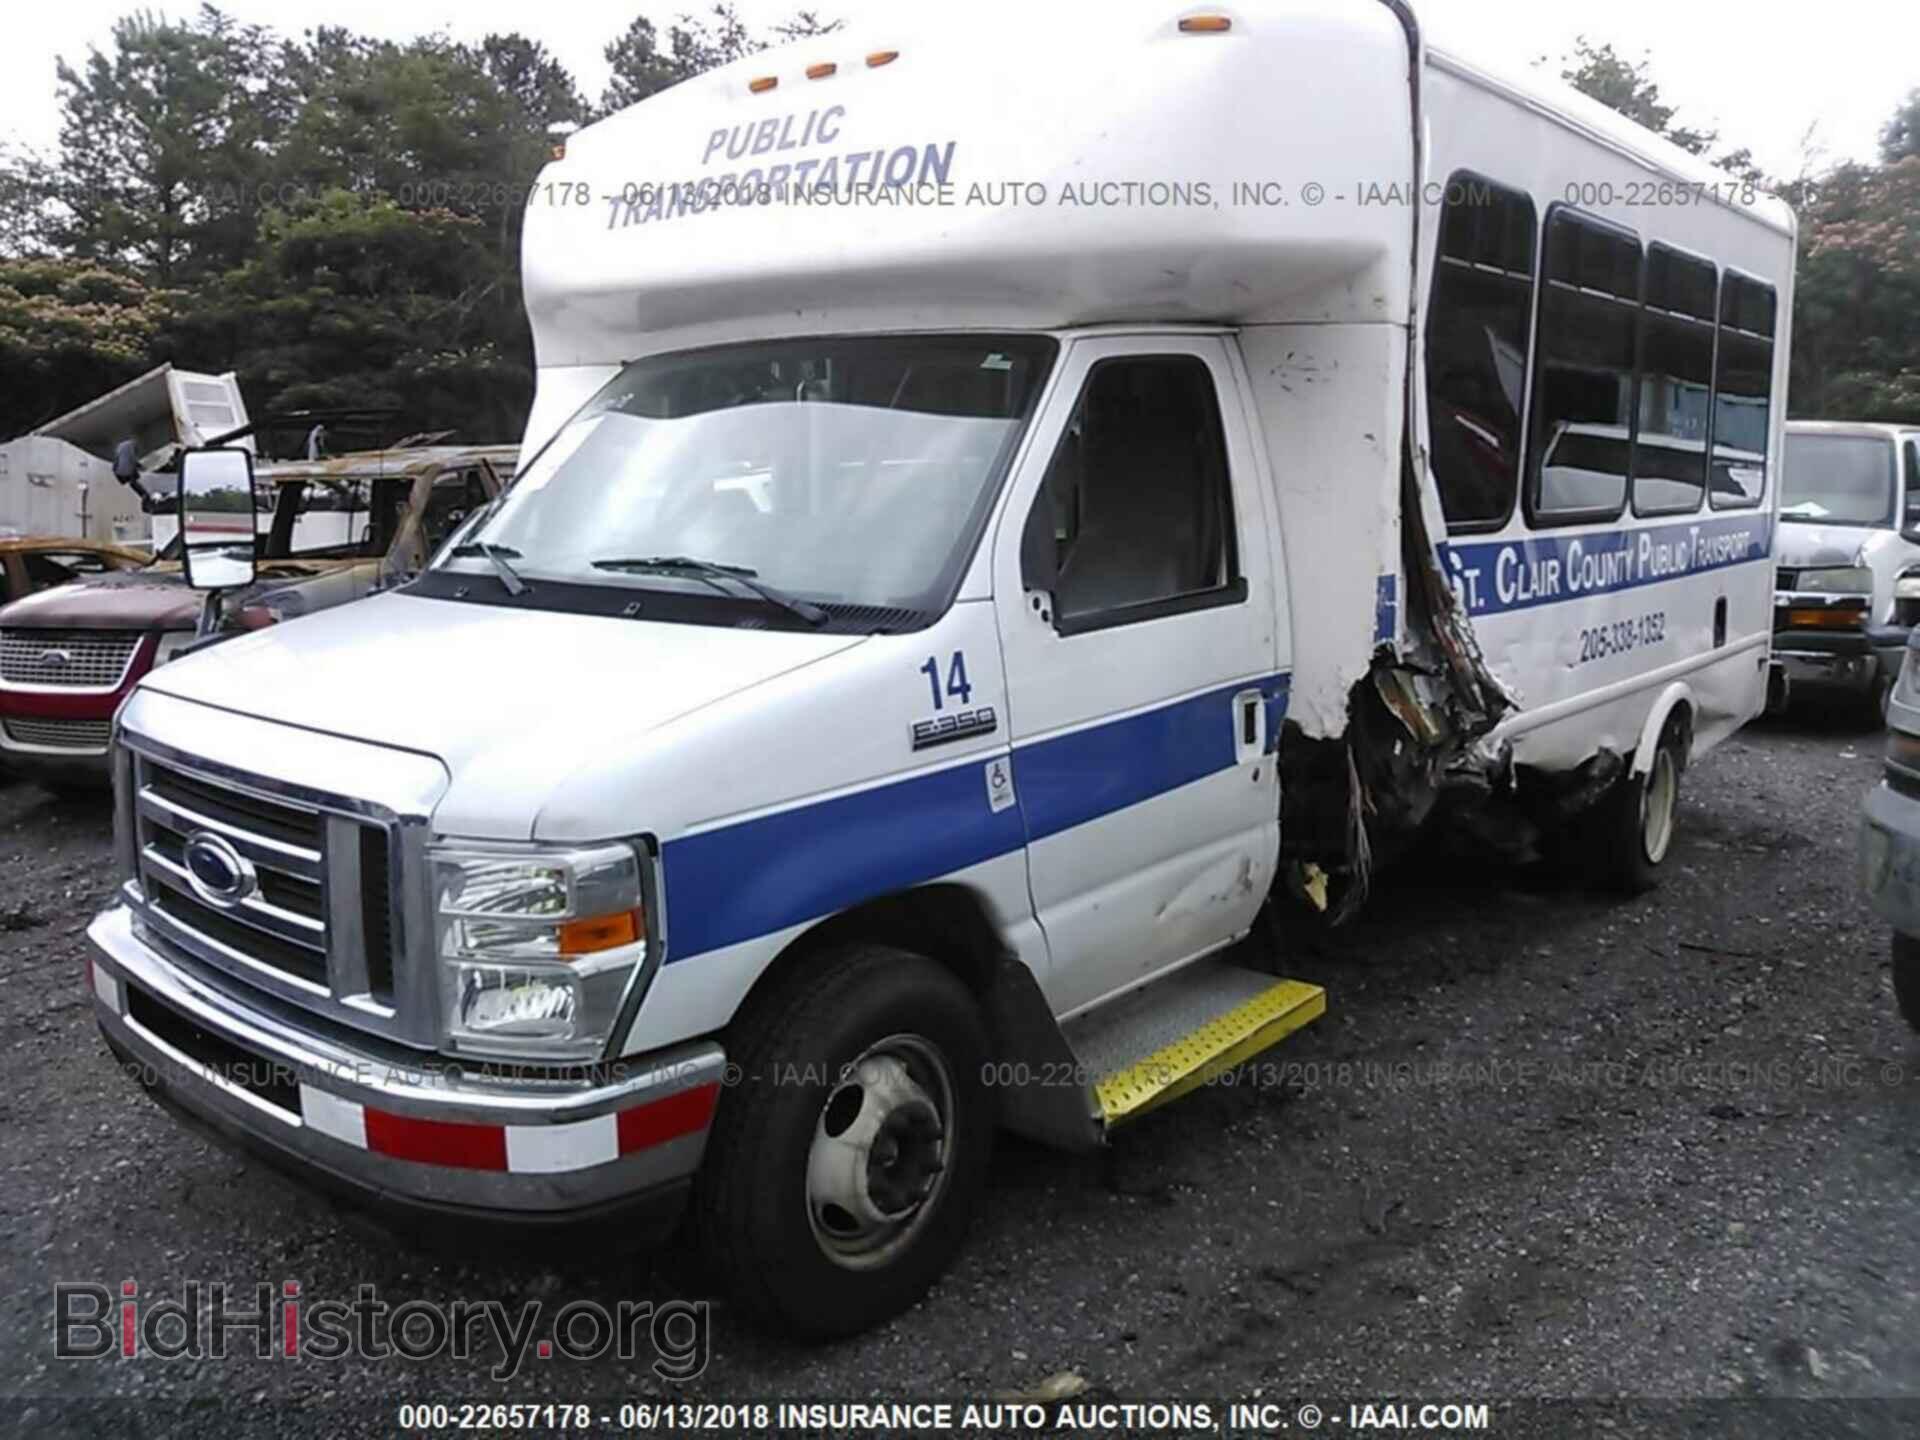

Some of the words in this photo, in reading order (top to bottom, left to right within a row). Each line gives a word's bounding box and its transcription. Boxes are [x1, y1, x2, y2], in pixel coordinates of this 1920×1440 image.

[701, 104, 846, 165] PUBLIC
[607, 140, 957, 231] TRANSPORTATION
[1495, 546, 1561, 604] CLAIR
[1566, 539, 1634, 593] COUNTY
[1637, 532, 1687, 579] PUBLIC
[919, 650, 972, 711] 14
